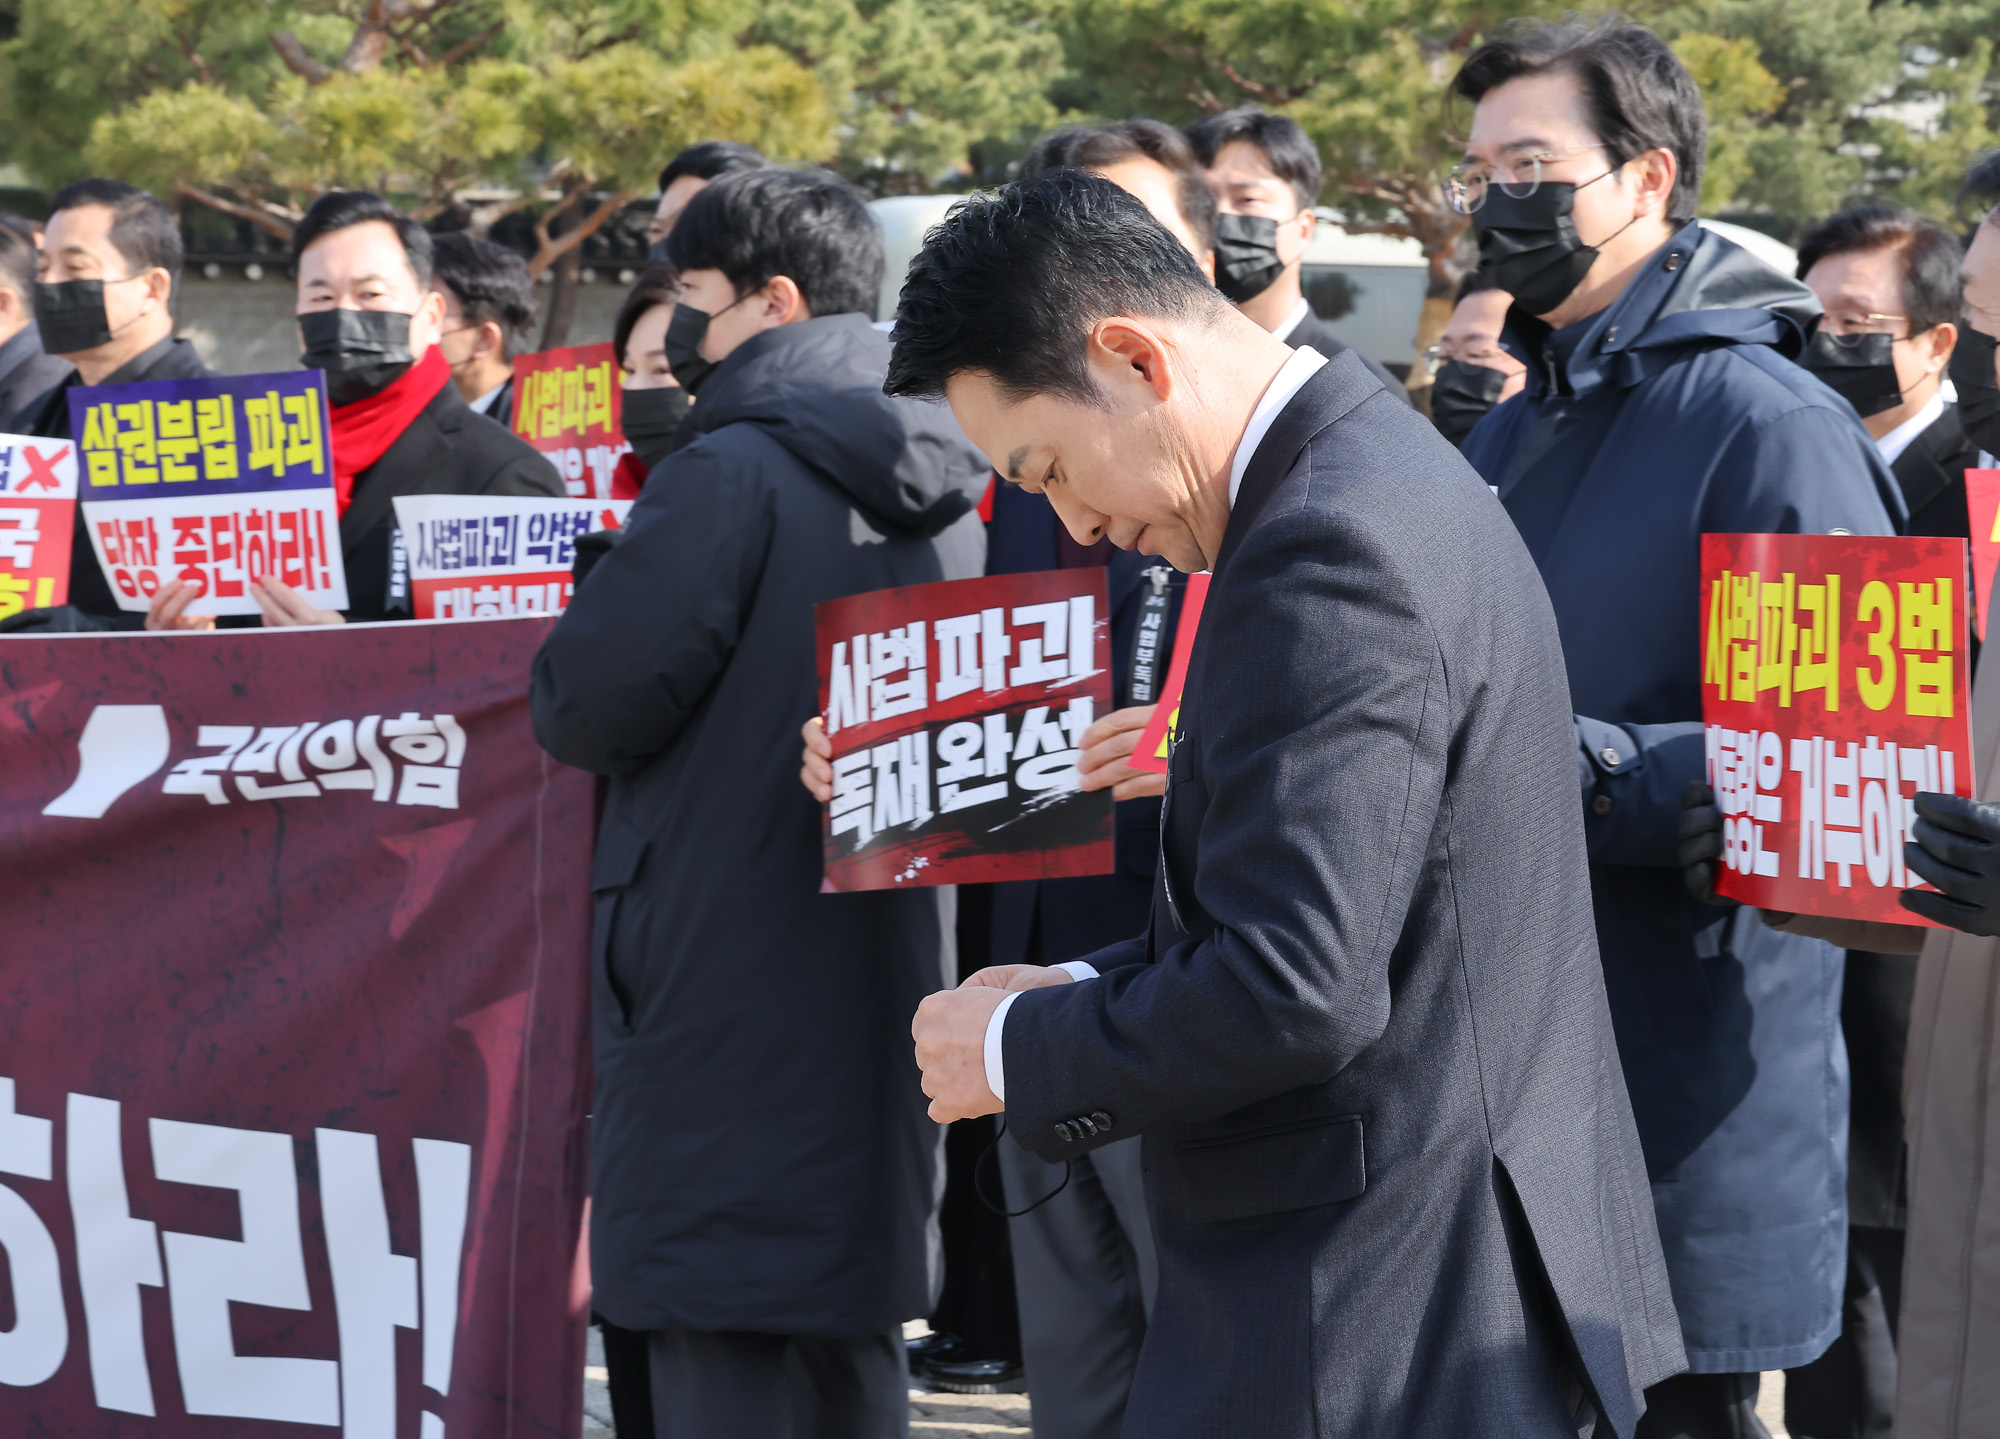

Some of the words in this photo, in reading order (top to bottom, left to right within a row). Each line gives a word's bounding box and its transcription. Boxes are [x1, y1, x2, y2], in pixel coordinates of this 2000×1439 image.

[82, 394, 239, 487] 삼권분립
[244, 387, 324, 477] 파괴
[517, 361, 612, 439] 사법파괴
[97, 517, 161, 598] 당장
[171, 508, 331, 599] 중단하라!
[418, 514, 519, 570] 사법파괴
[827, 620, 929, 737] 사법
[934, 594, 1096, 702] 파괴
[1705, 570, 1840, 712] 사법파괴
[1856, 580, 1896, 711] 3
[1899, 577, 1954, 717] 법
[163, 712, 467, 809] 국민의힘
[830, 730, 934, 838] 독재
[936, 696, 1094, 814] 완성
